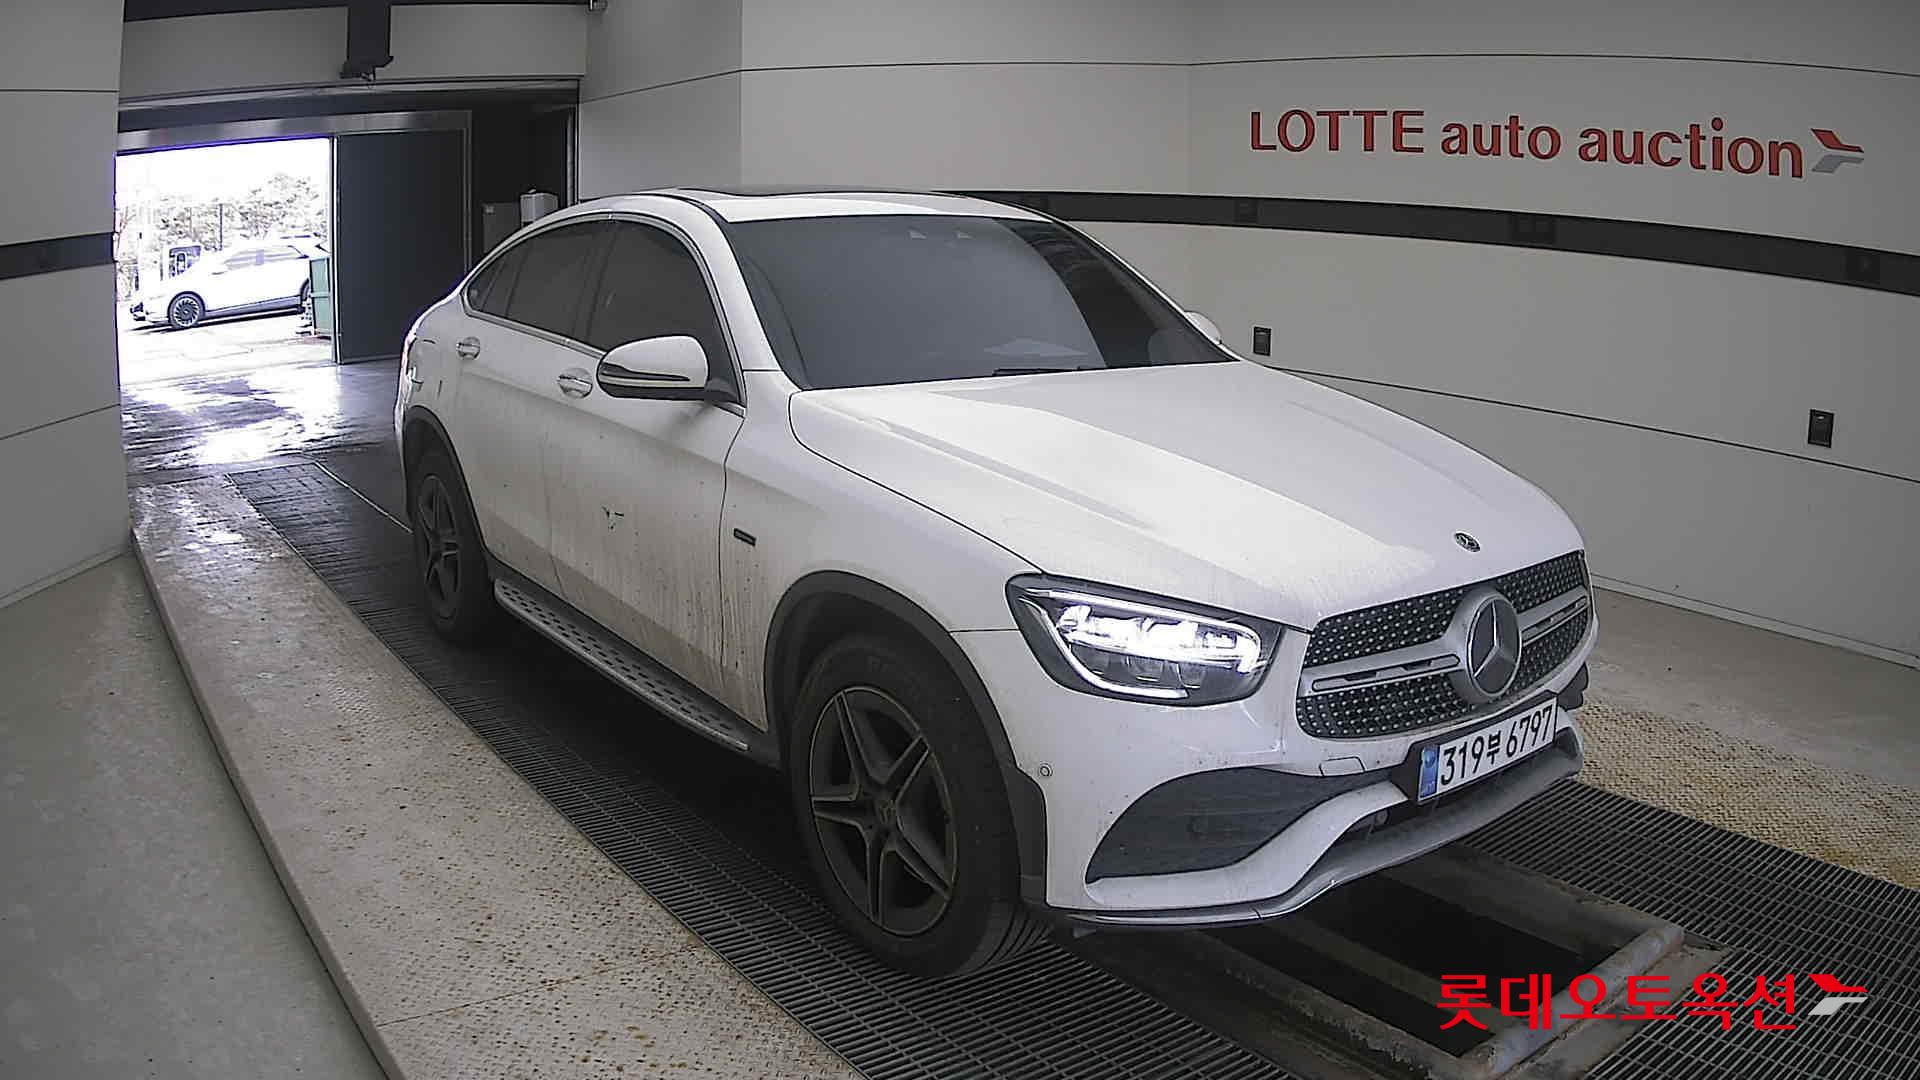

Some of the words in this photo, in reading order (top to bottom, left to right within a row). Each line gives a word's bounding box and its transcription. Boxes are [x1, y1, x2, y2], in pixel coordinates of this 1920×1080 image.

[1251, 110, 1424, 153] LOTTE
[1441, 115, 1561, 160] auto
[1578, 117, 1804, 178] auction
